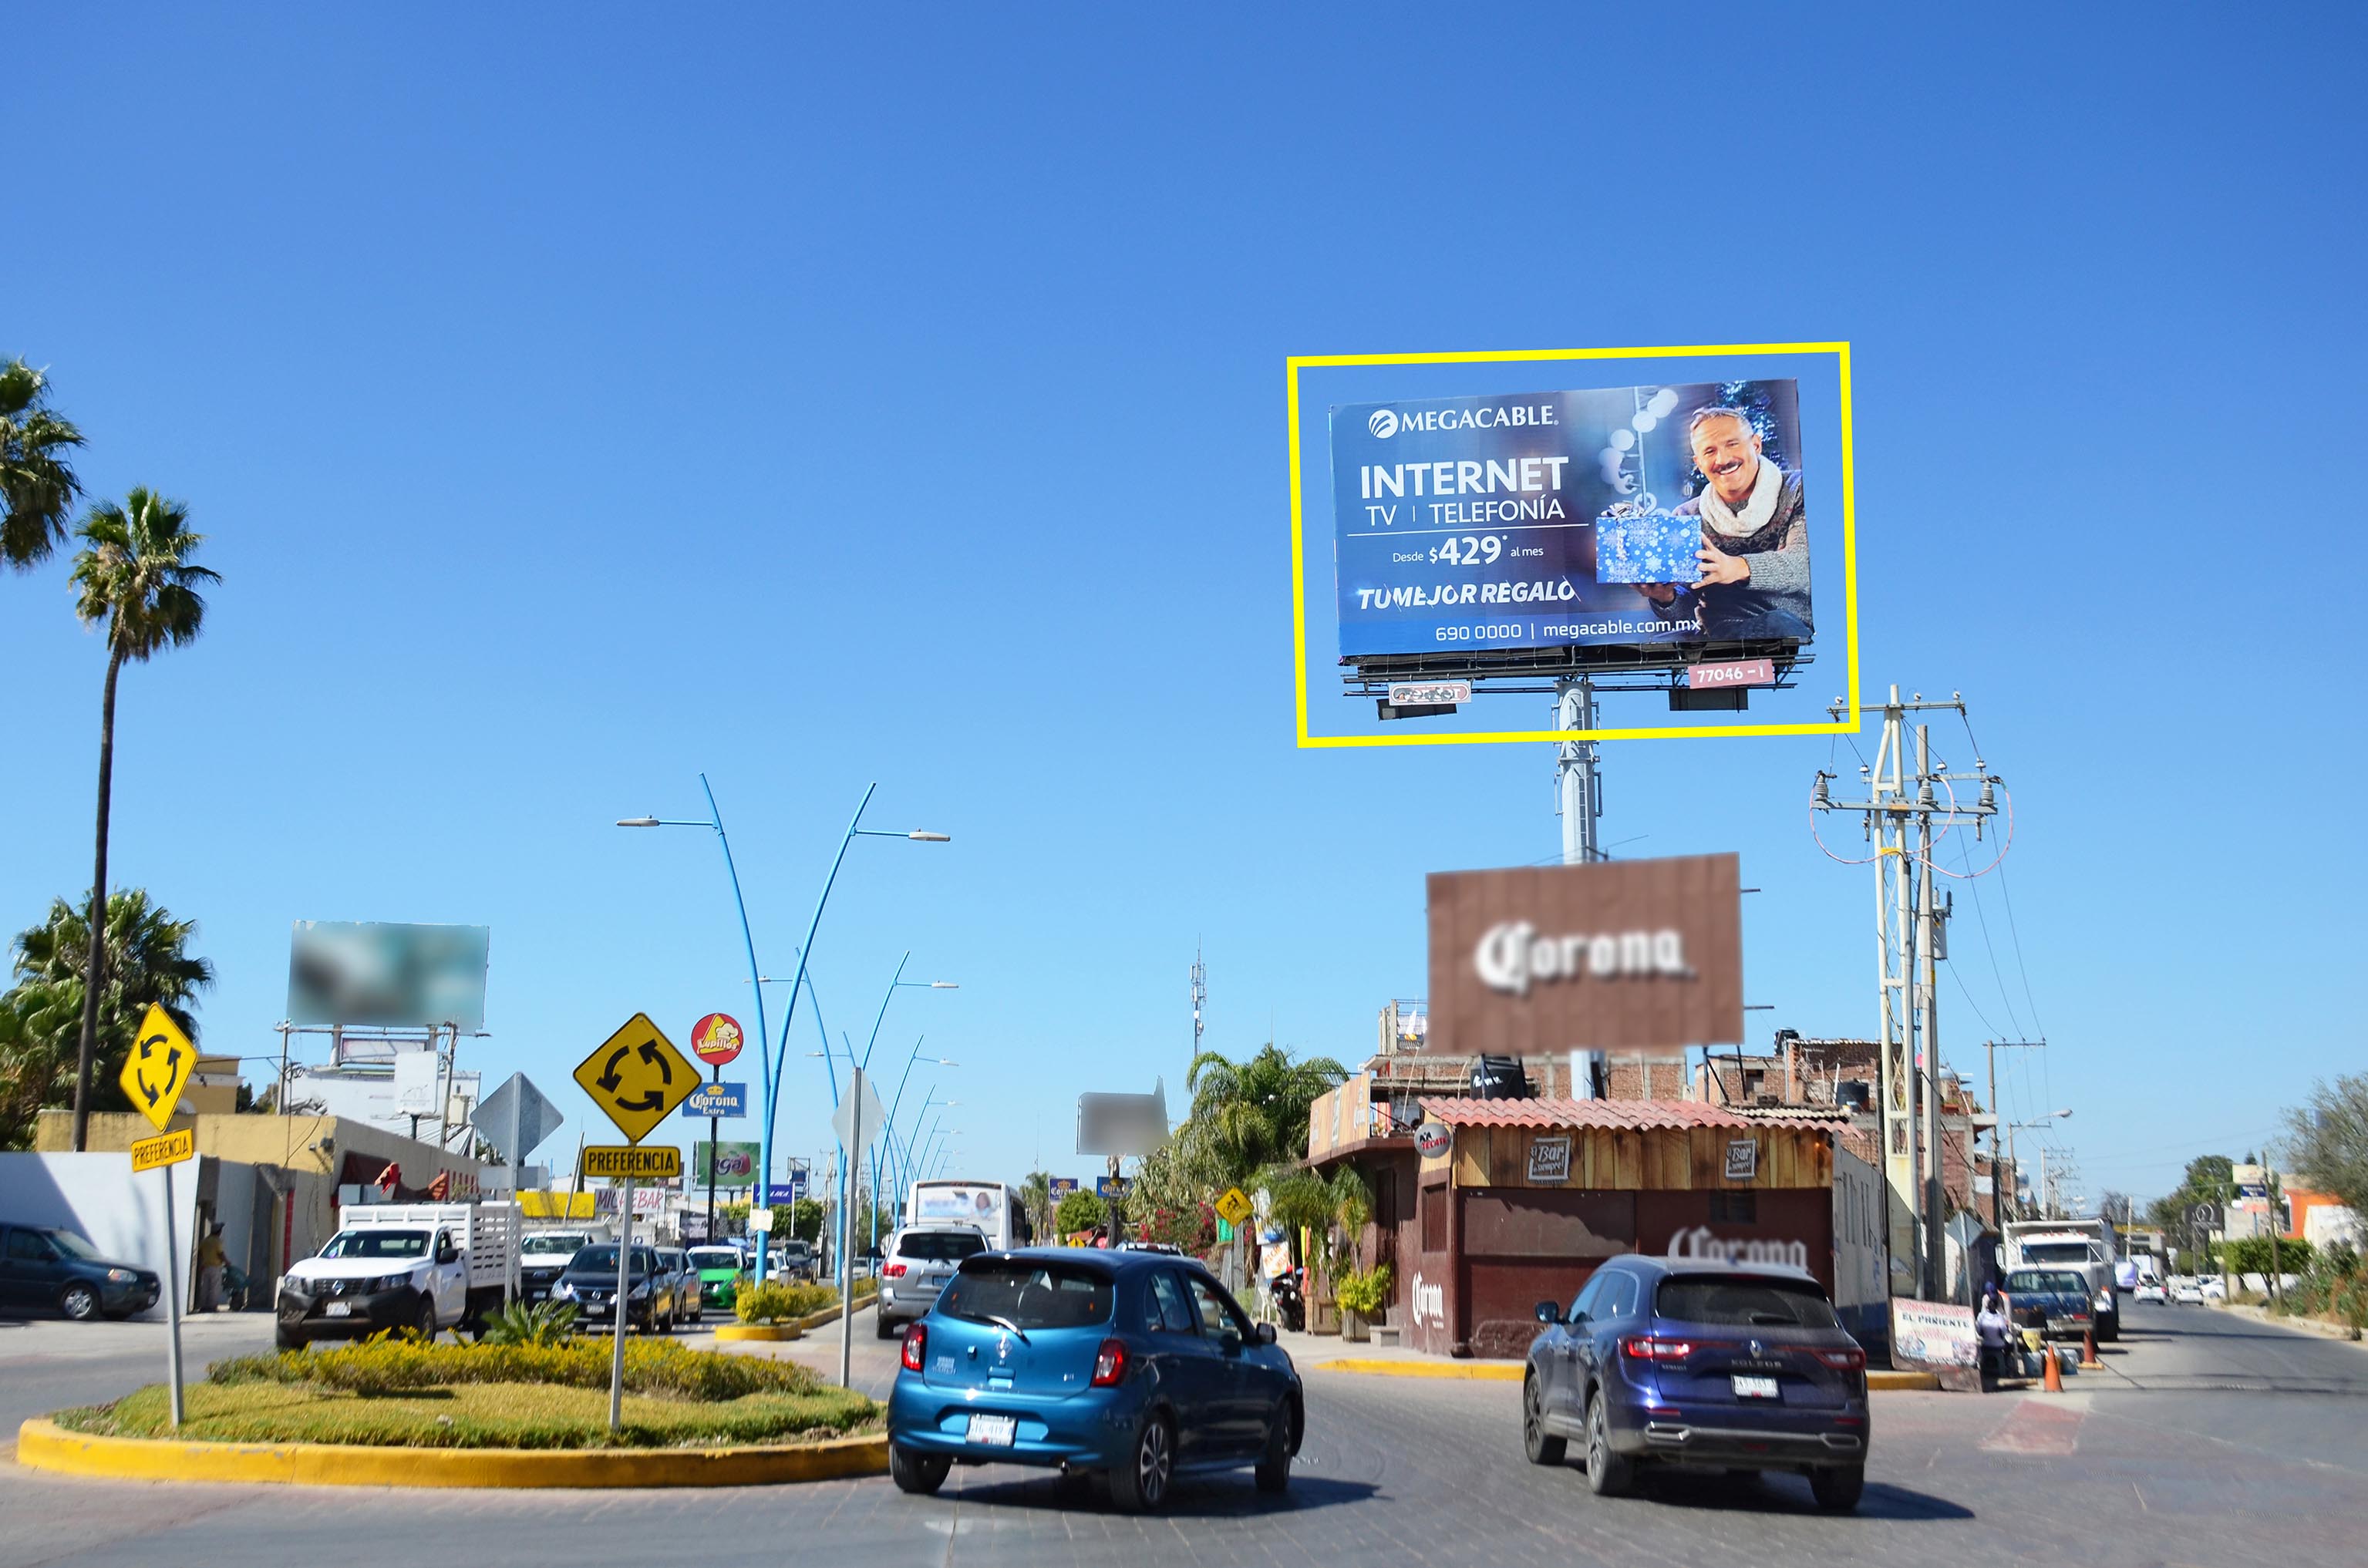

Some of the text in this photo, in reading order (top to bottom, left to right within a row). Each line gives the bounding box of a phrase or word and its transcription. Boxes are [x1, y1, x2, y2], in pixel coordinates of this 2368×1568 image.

[1401, 405, 1554, 432] MEGACABLE
[1361, 456, 1569, 499] INTERNET
[1365, 494, 1565, 526] TV TELEFONÍA
[1393, 551, 1424, 563] Desde
[1510, 547, 1521, 557] al
[1522, 548, 1544, 557] mes
[1480, 580, 1578, 604] REGALO
[1436, 619, 1702, 641] 690 0000 megacable.com.mx
[1474, 920, 1697, 996] Corona
[689, 1093, 739, 1110] Corona
[702, 1106, 725, 1115] Extra
[134, 1136, 190, 1167] PREFERENCIA
[1420, 1136, 1448, 1150] TECATE
[1538, 1146, 1565, 1163] Bar
[588, 1151, 675, 1172] PREFERENCIA
[1412, 1270, 1444, 1330] Corona
